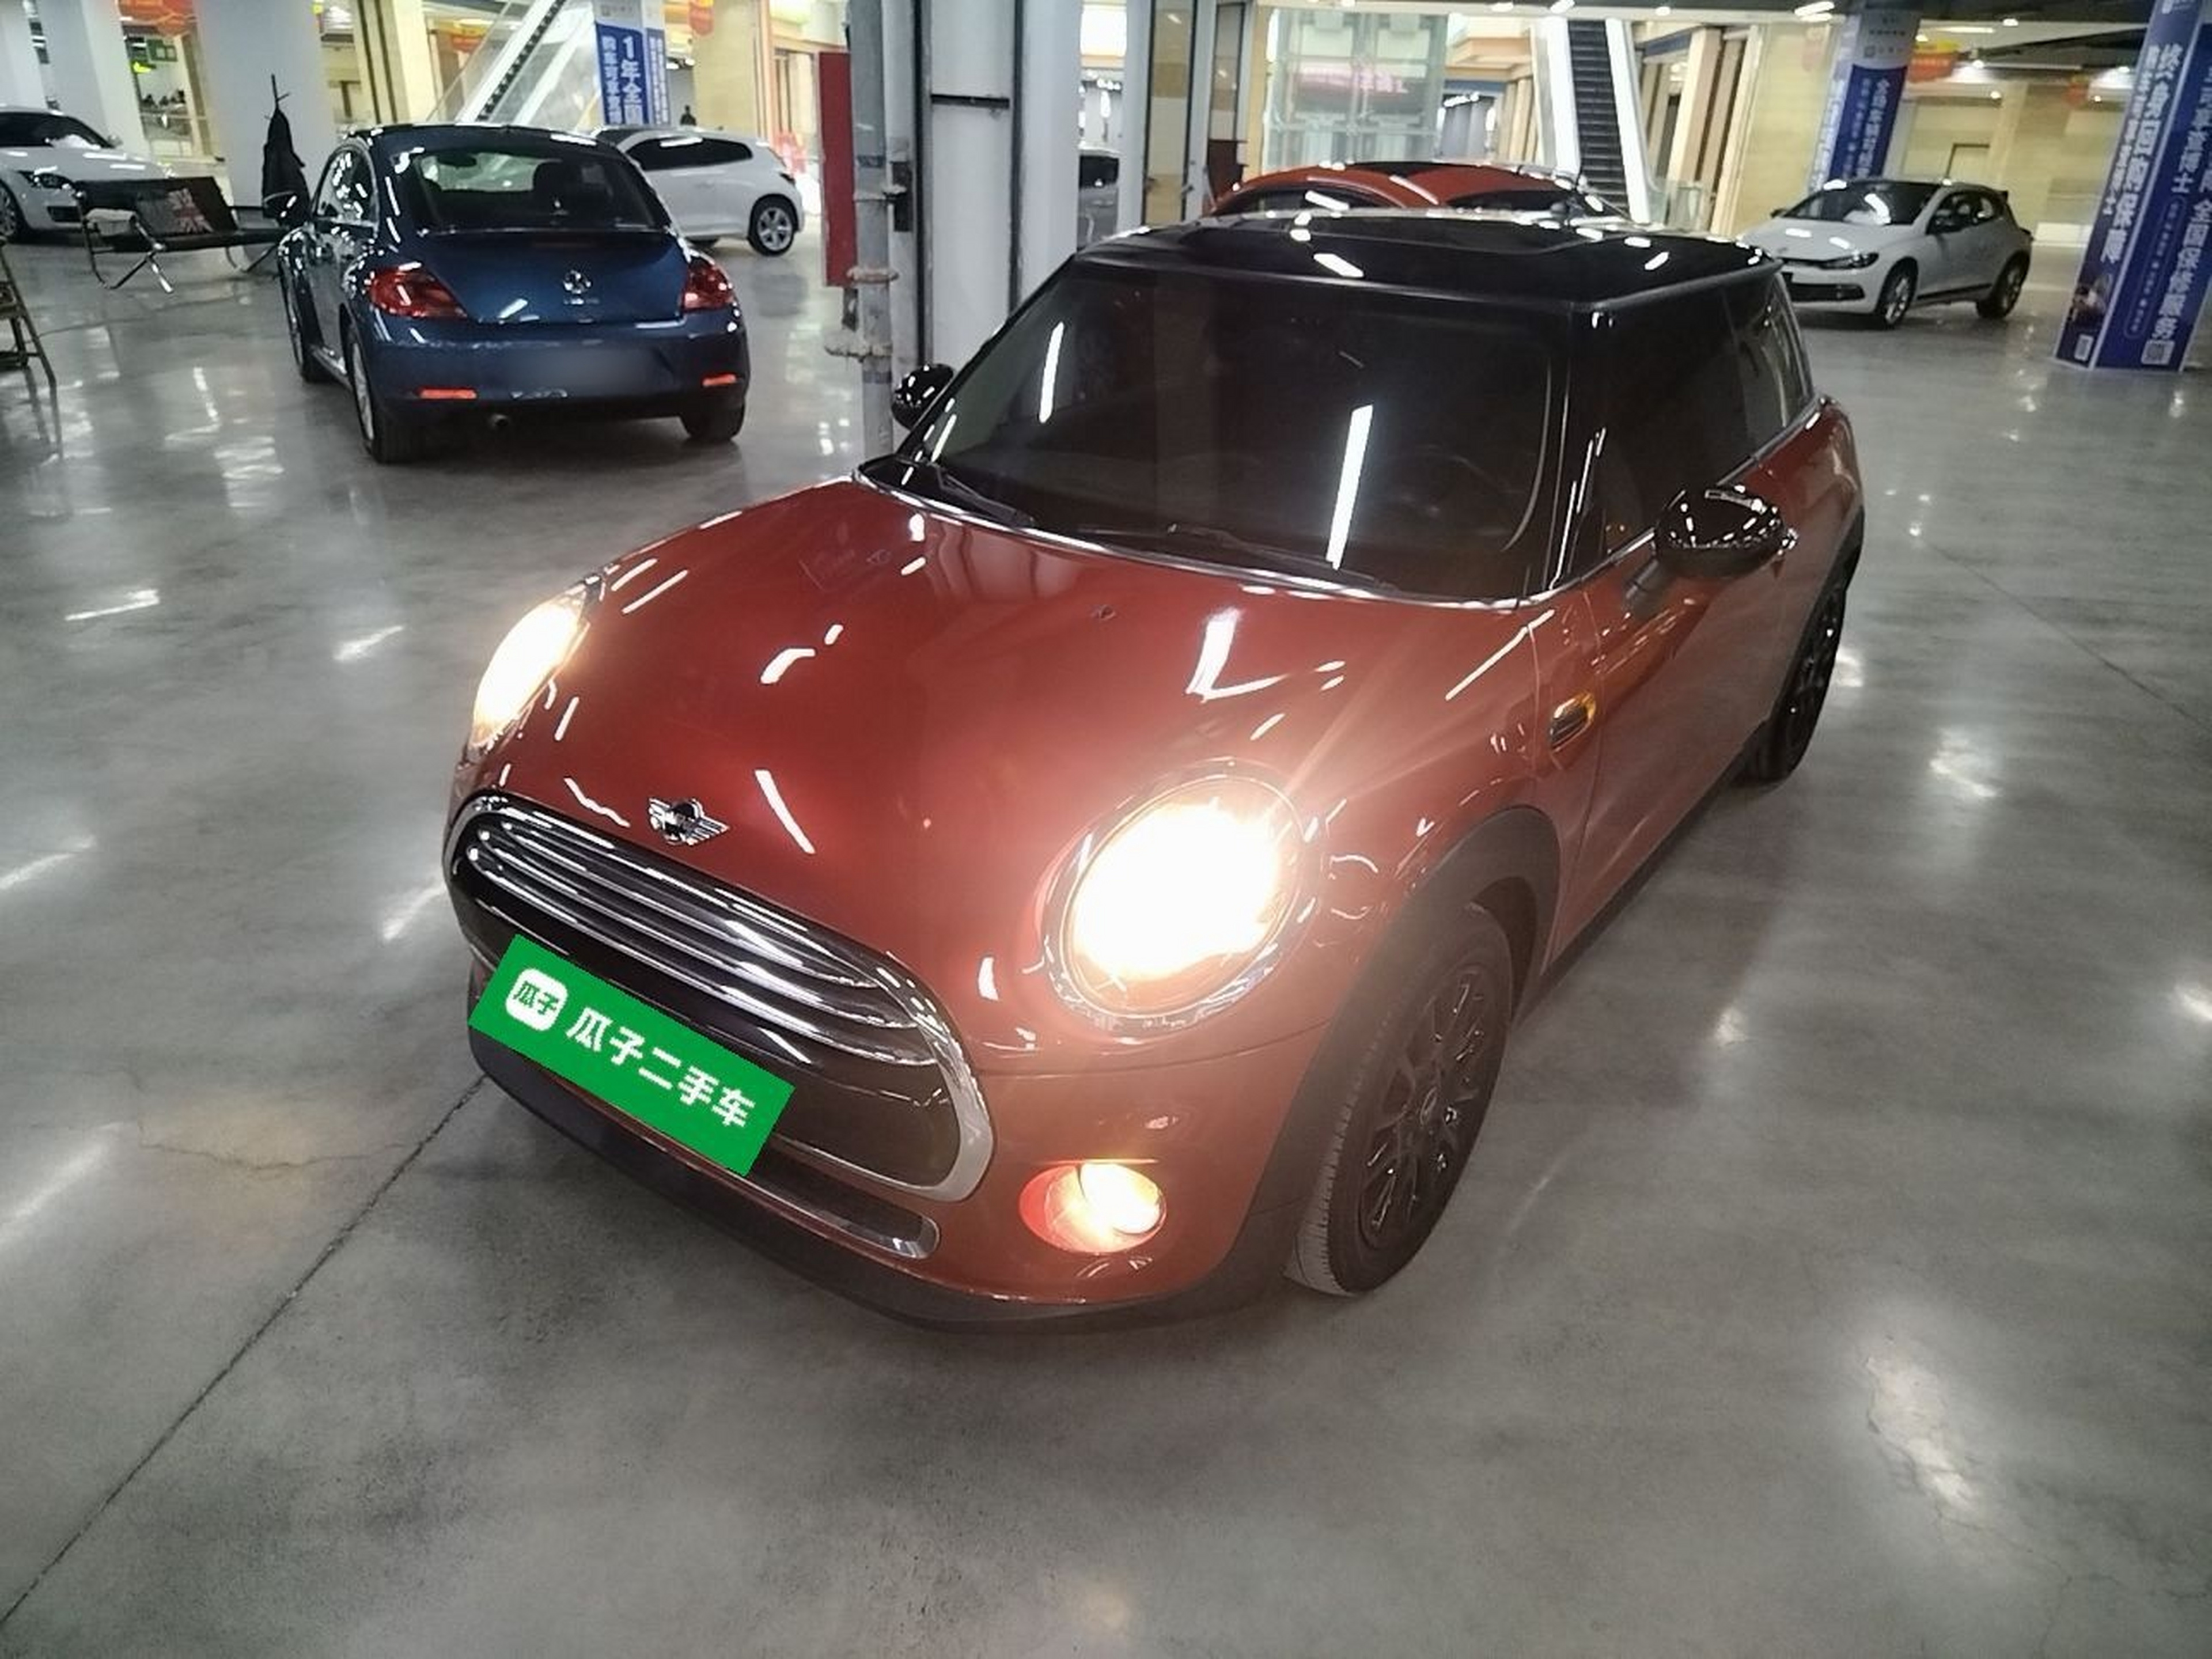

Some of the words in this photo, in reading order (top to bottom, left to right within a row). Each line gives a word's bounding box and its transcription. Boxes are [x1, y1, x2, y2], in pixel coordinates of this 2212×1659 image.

[2100, 43, 2183, 264] 终身回购保障
